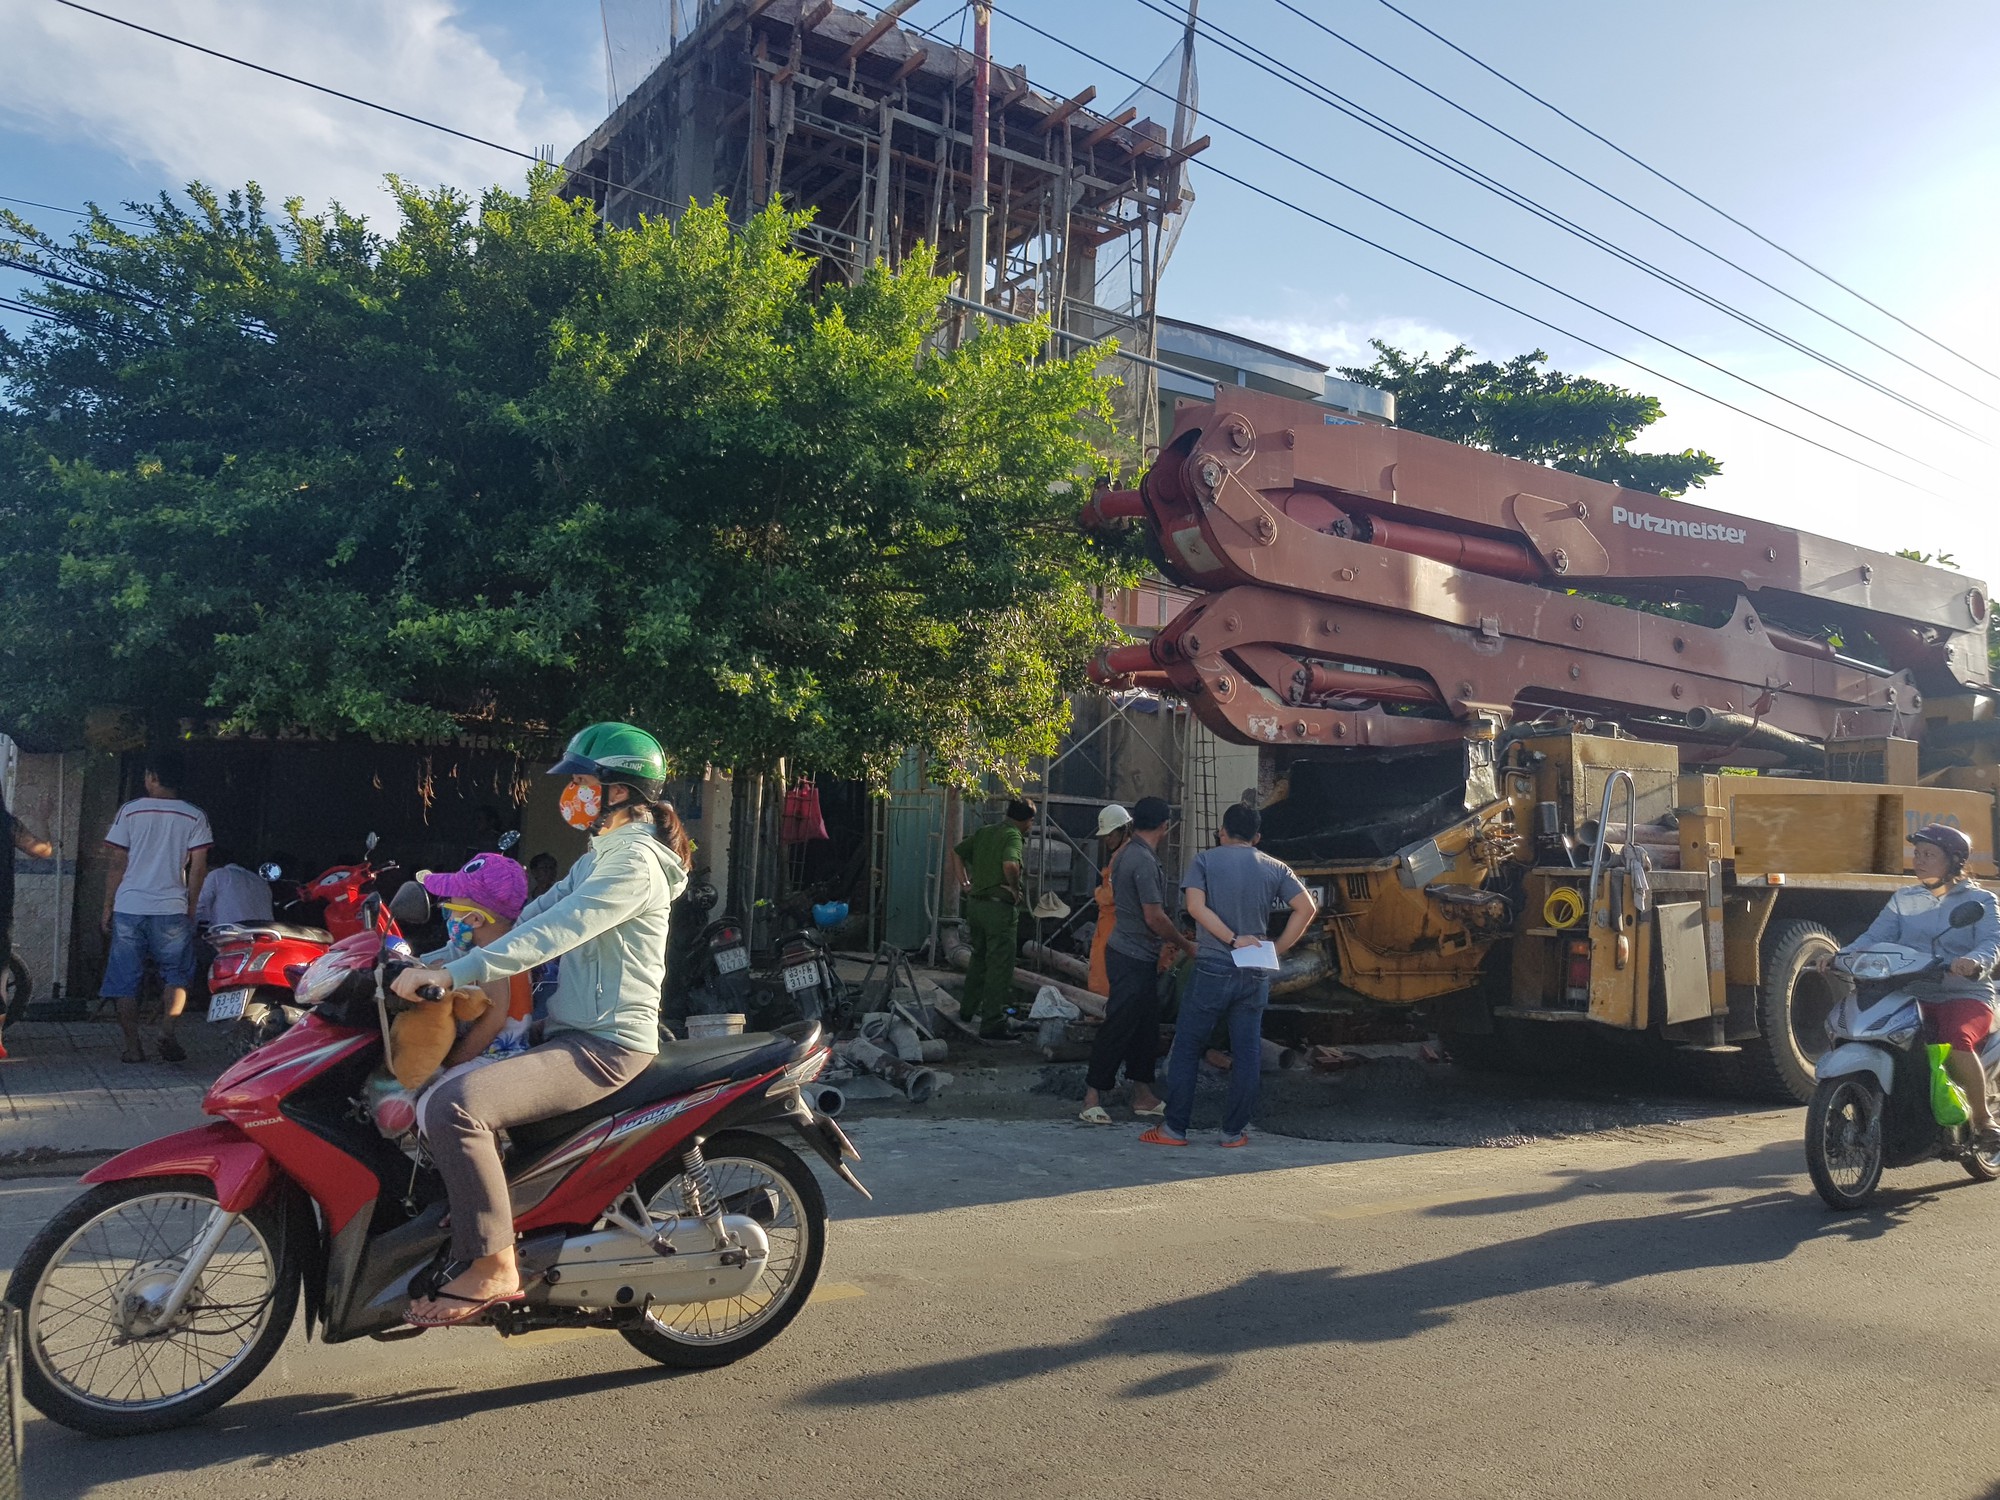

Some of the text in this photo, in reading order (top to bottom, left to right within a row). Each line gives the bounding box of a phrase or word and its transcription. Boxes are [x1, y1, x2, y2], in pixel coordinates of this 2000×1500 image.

[1612, 505, 1747, 544] Putzmeister
[790, 974, 814, 988] 3119
[244, 1115, 285, 1129] HONDA
